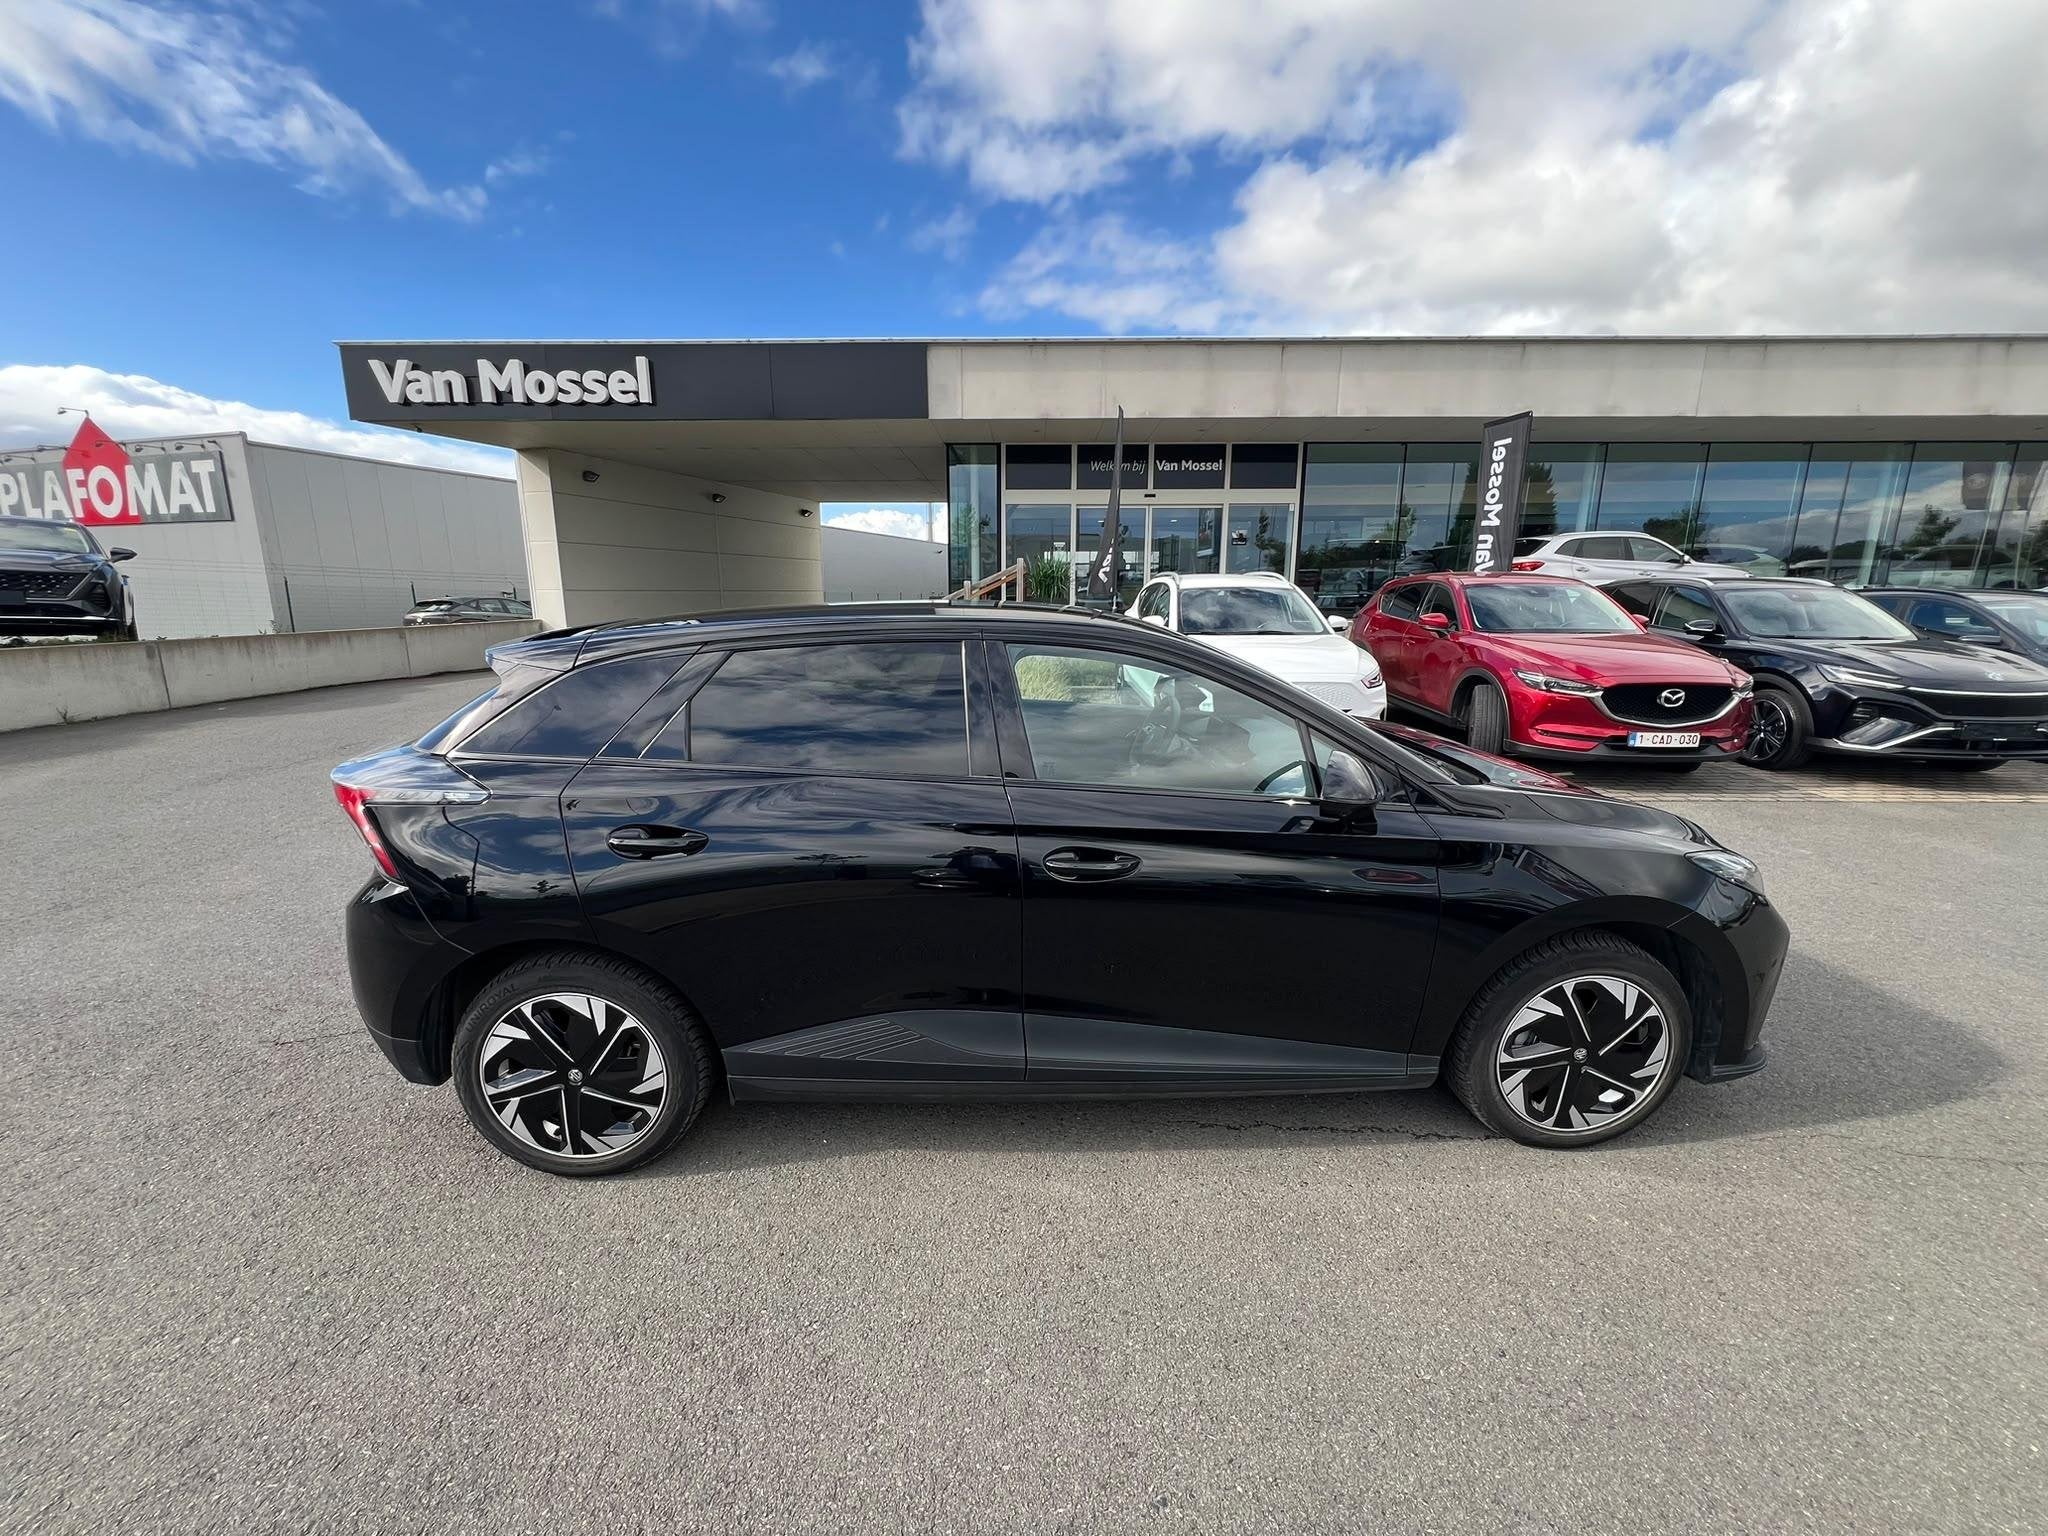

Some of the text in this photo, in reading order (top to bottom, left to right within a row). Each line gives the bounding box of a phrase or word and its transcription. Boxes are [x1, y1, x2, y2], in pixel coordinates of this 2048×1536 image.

[367, 356, 653, 405] Van Mossel
[0, 459, 217, 520] PLAFOMAT
[1090, 459, 1223, 474] Welkm bij Van Mossel
[1639, 734, 1699, 745] 1-CAD-030
[465, 983, 520, 1033] UNIROYAL
